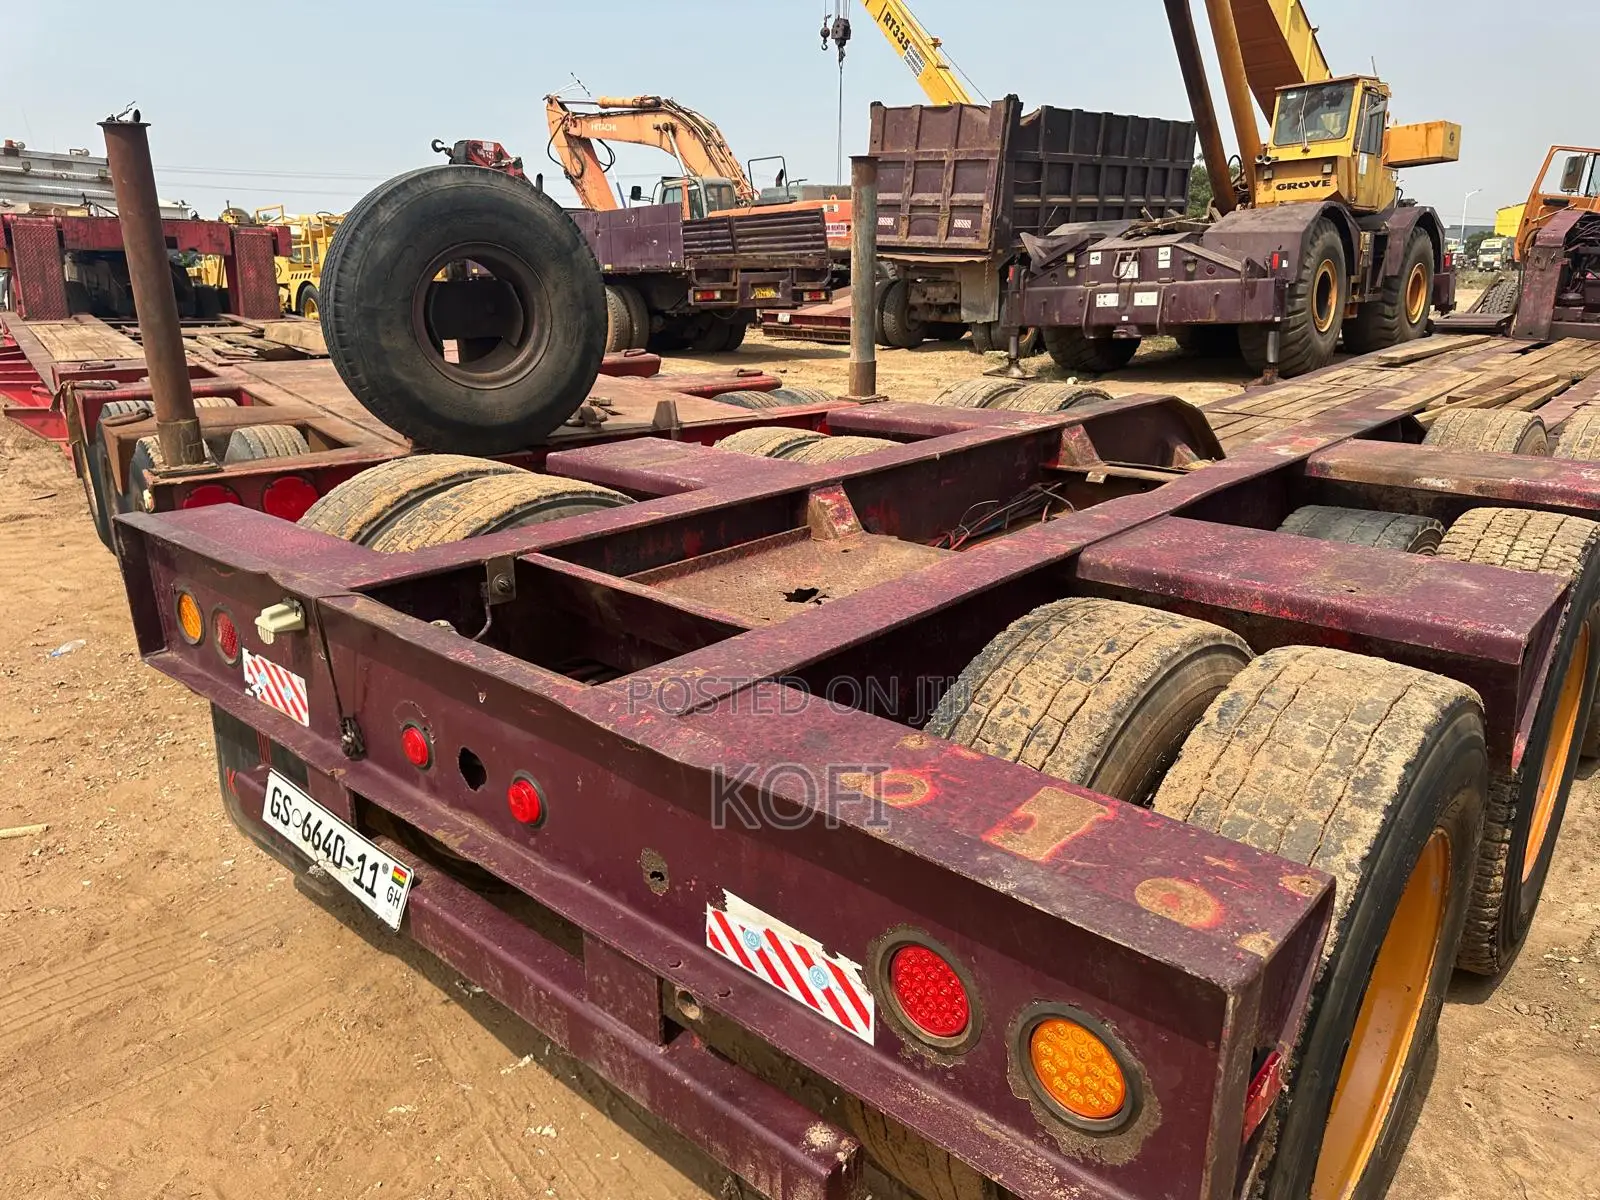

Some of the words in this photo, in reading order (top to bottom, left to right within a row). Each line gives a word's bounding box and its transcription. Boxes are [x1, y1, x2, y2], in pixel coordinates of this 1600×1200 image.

[883, 11, 910, 51] RT335
[591, 122, 617, 131] HITACHI
[1275, 179, 1332, 191] GROVE
[386, 886, 402, 910] GH
